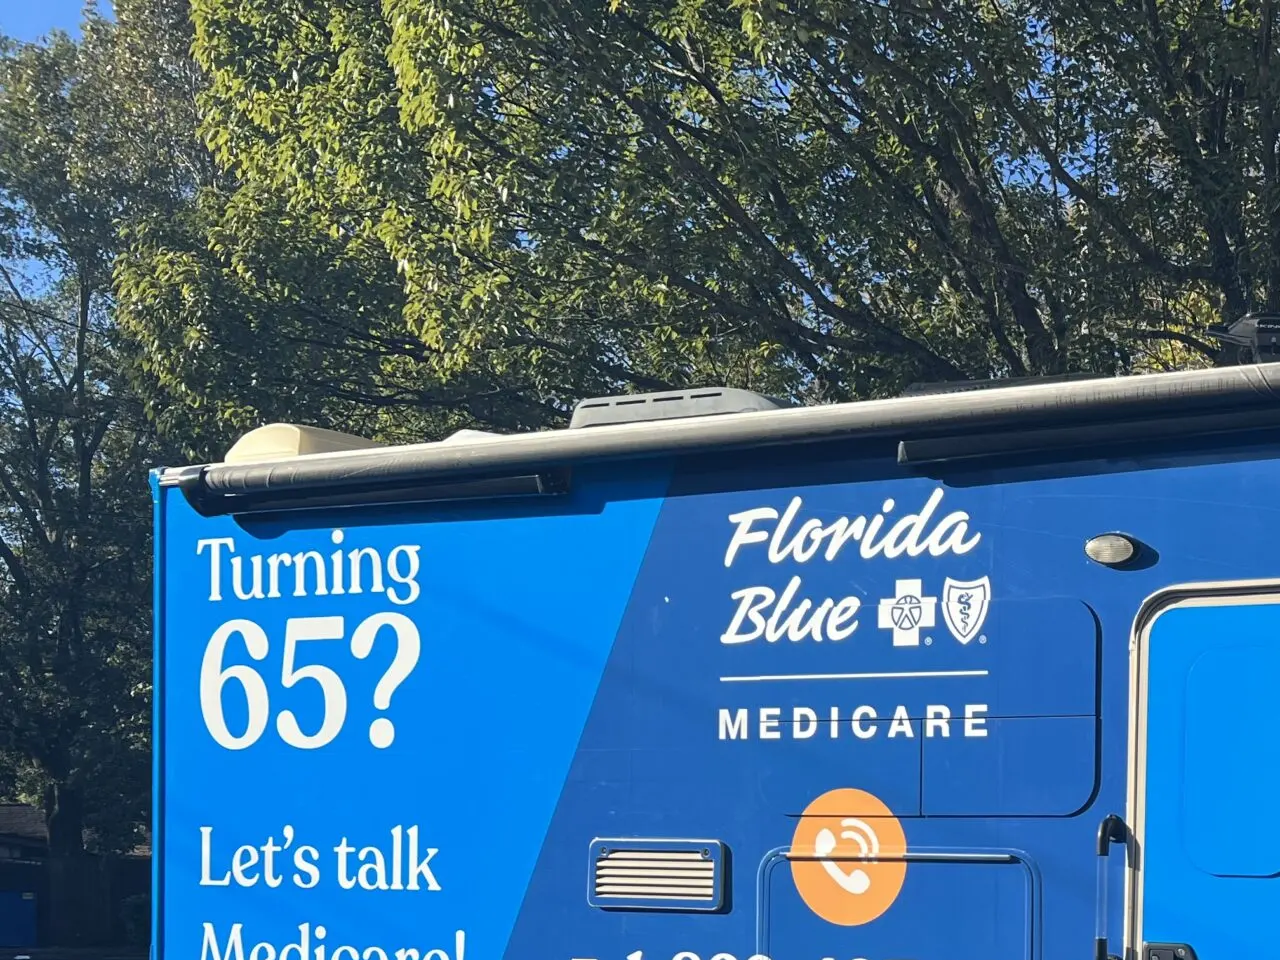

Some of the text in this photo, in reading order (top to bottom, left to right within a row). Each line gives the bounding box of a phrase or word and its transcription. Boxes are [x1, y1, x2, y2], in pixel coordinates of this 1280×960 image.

[724, 487, 982, 568] Florida
[196, 529, 421, 605] Turning
[720, 575, 861, 644] Blue
[200, 611, 421, 750] 65?
[718, 704, 988, 740] MEDICARE
[199, 825, 442, 891] Let's talk
